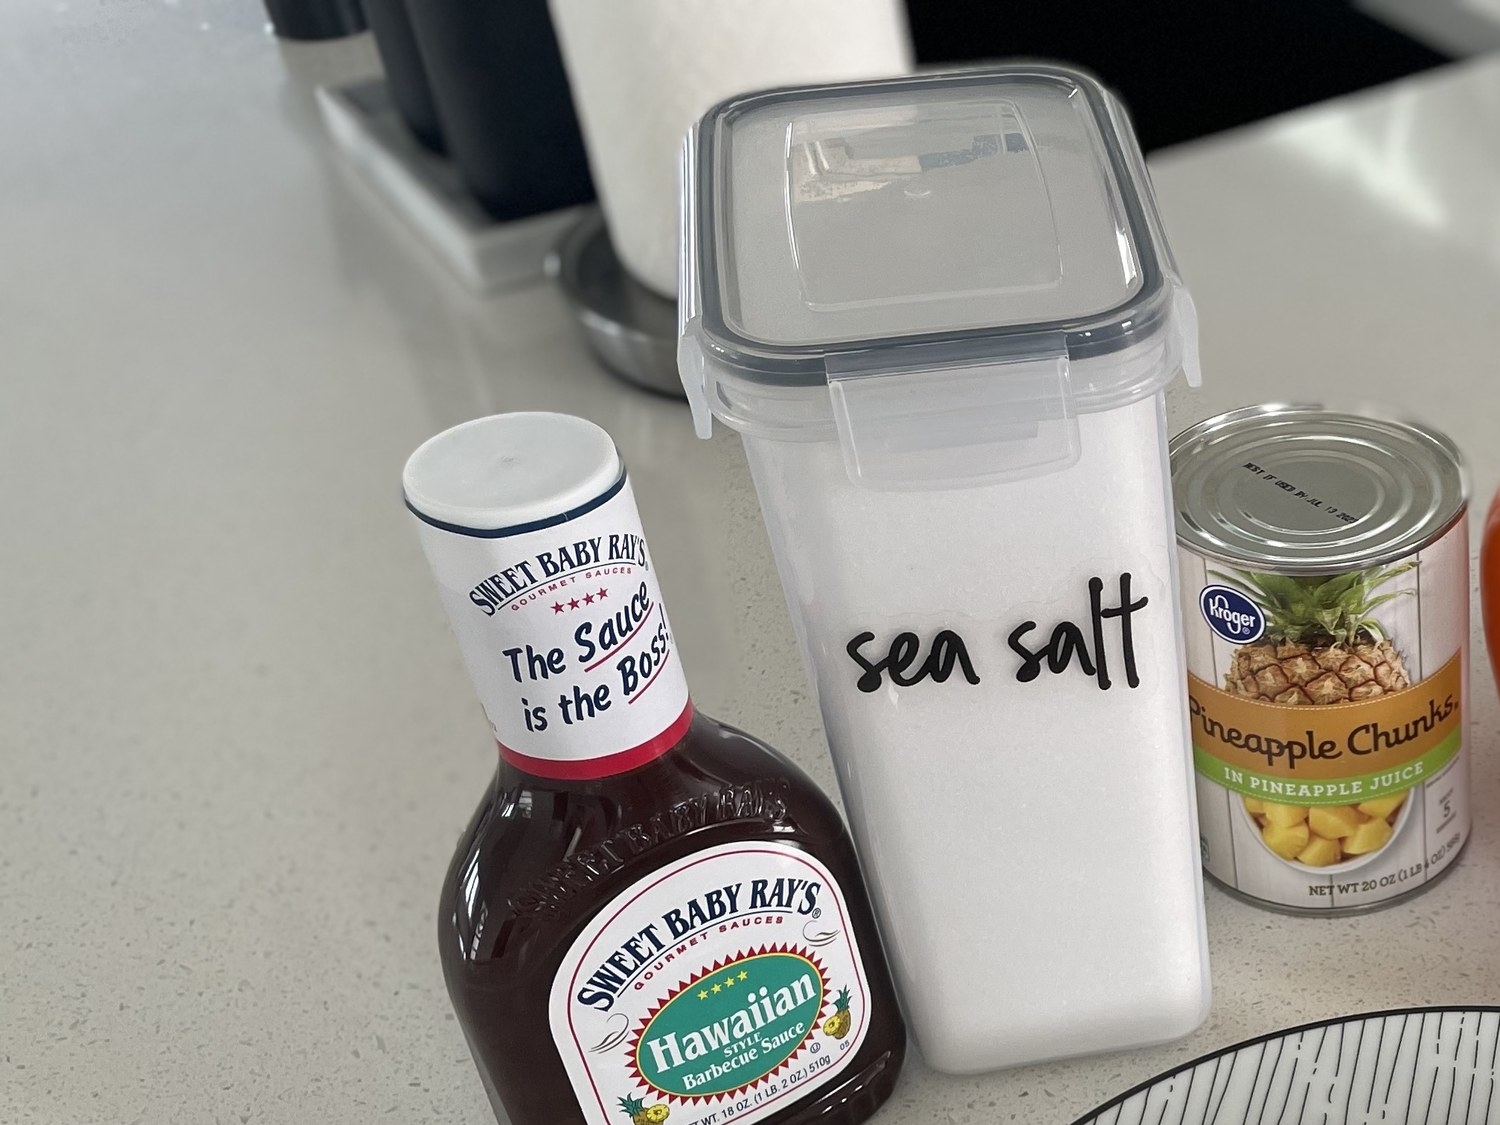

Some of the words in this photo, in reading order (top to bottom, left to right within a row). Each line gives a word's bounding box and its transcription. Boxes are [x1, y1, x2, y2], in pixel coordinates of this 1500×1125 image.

[469, 561, 538, 616] SWEET
[536, 537, 602, 577] BABY
[608, 534, 646, 567] RAY'S
[511, 576, 576, 611] GOURMET
[586, 566, 632, 579] SAUCES
[502, 644, 566, 683] The
[574, 581, 650, 663] Sauce
[846, 629, 980, 693] sea
[1008, 572, 1149, 690] salt
[1209, 594, 1256, 635] Kroger
[521, 697, 548, 732] is
[558, 684, 612, 725] the
[616, 603, 669, 696] Boss!
[1189, 694, 1342, 770] Pineapple
[1224, 767, 1243, 785] IN
[1250, 776, 1363, 797] PINEAPPLE
[1369, 761, 1424, 790] JUICE
[1309, 885, 1334, 897] NET
[1337, 882, 1359, 894] WT
[1362, 879, 1377, 892] 20
[1379, 874, 1396, 888] OZ
[1410, 863, 1422, 877] LB
[577, 923, 666, 1012] SWEET
[662, 883, 742, 940] BABY
[749, 878, 821, 915] RAY'S
[634, 931, 708, 991] GOURMET
[719, 916, 784, 933] SAUCES
[647, 973, 817, 1074] Hawaiian
[682, 1048, 759, 1090] Barbecue
[760, 1022, 806, 1055] Sauce
[723, 1031, 764, 1058] STYLE
[722, 1106, 735, 1119] 18
[736, 1098, 753, 1112] OZ.
[754, 1092, 763, 1105] (1
[765, 1085, 781, 1100] LB.
[781, 1078, 788, 1090] 2
[808, 1053, 831, 1074] 510g
